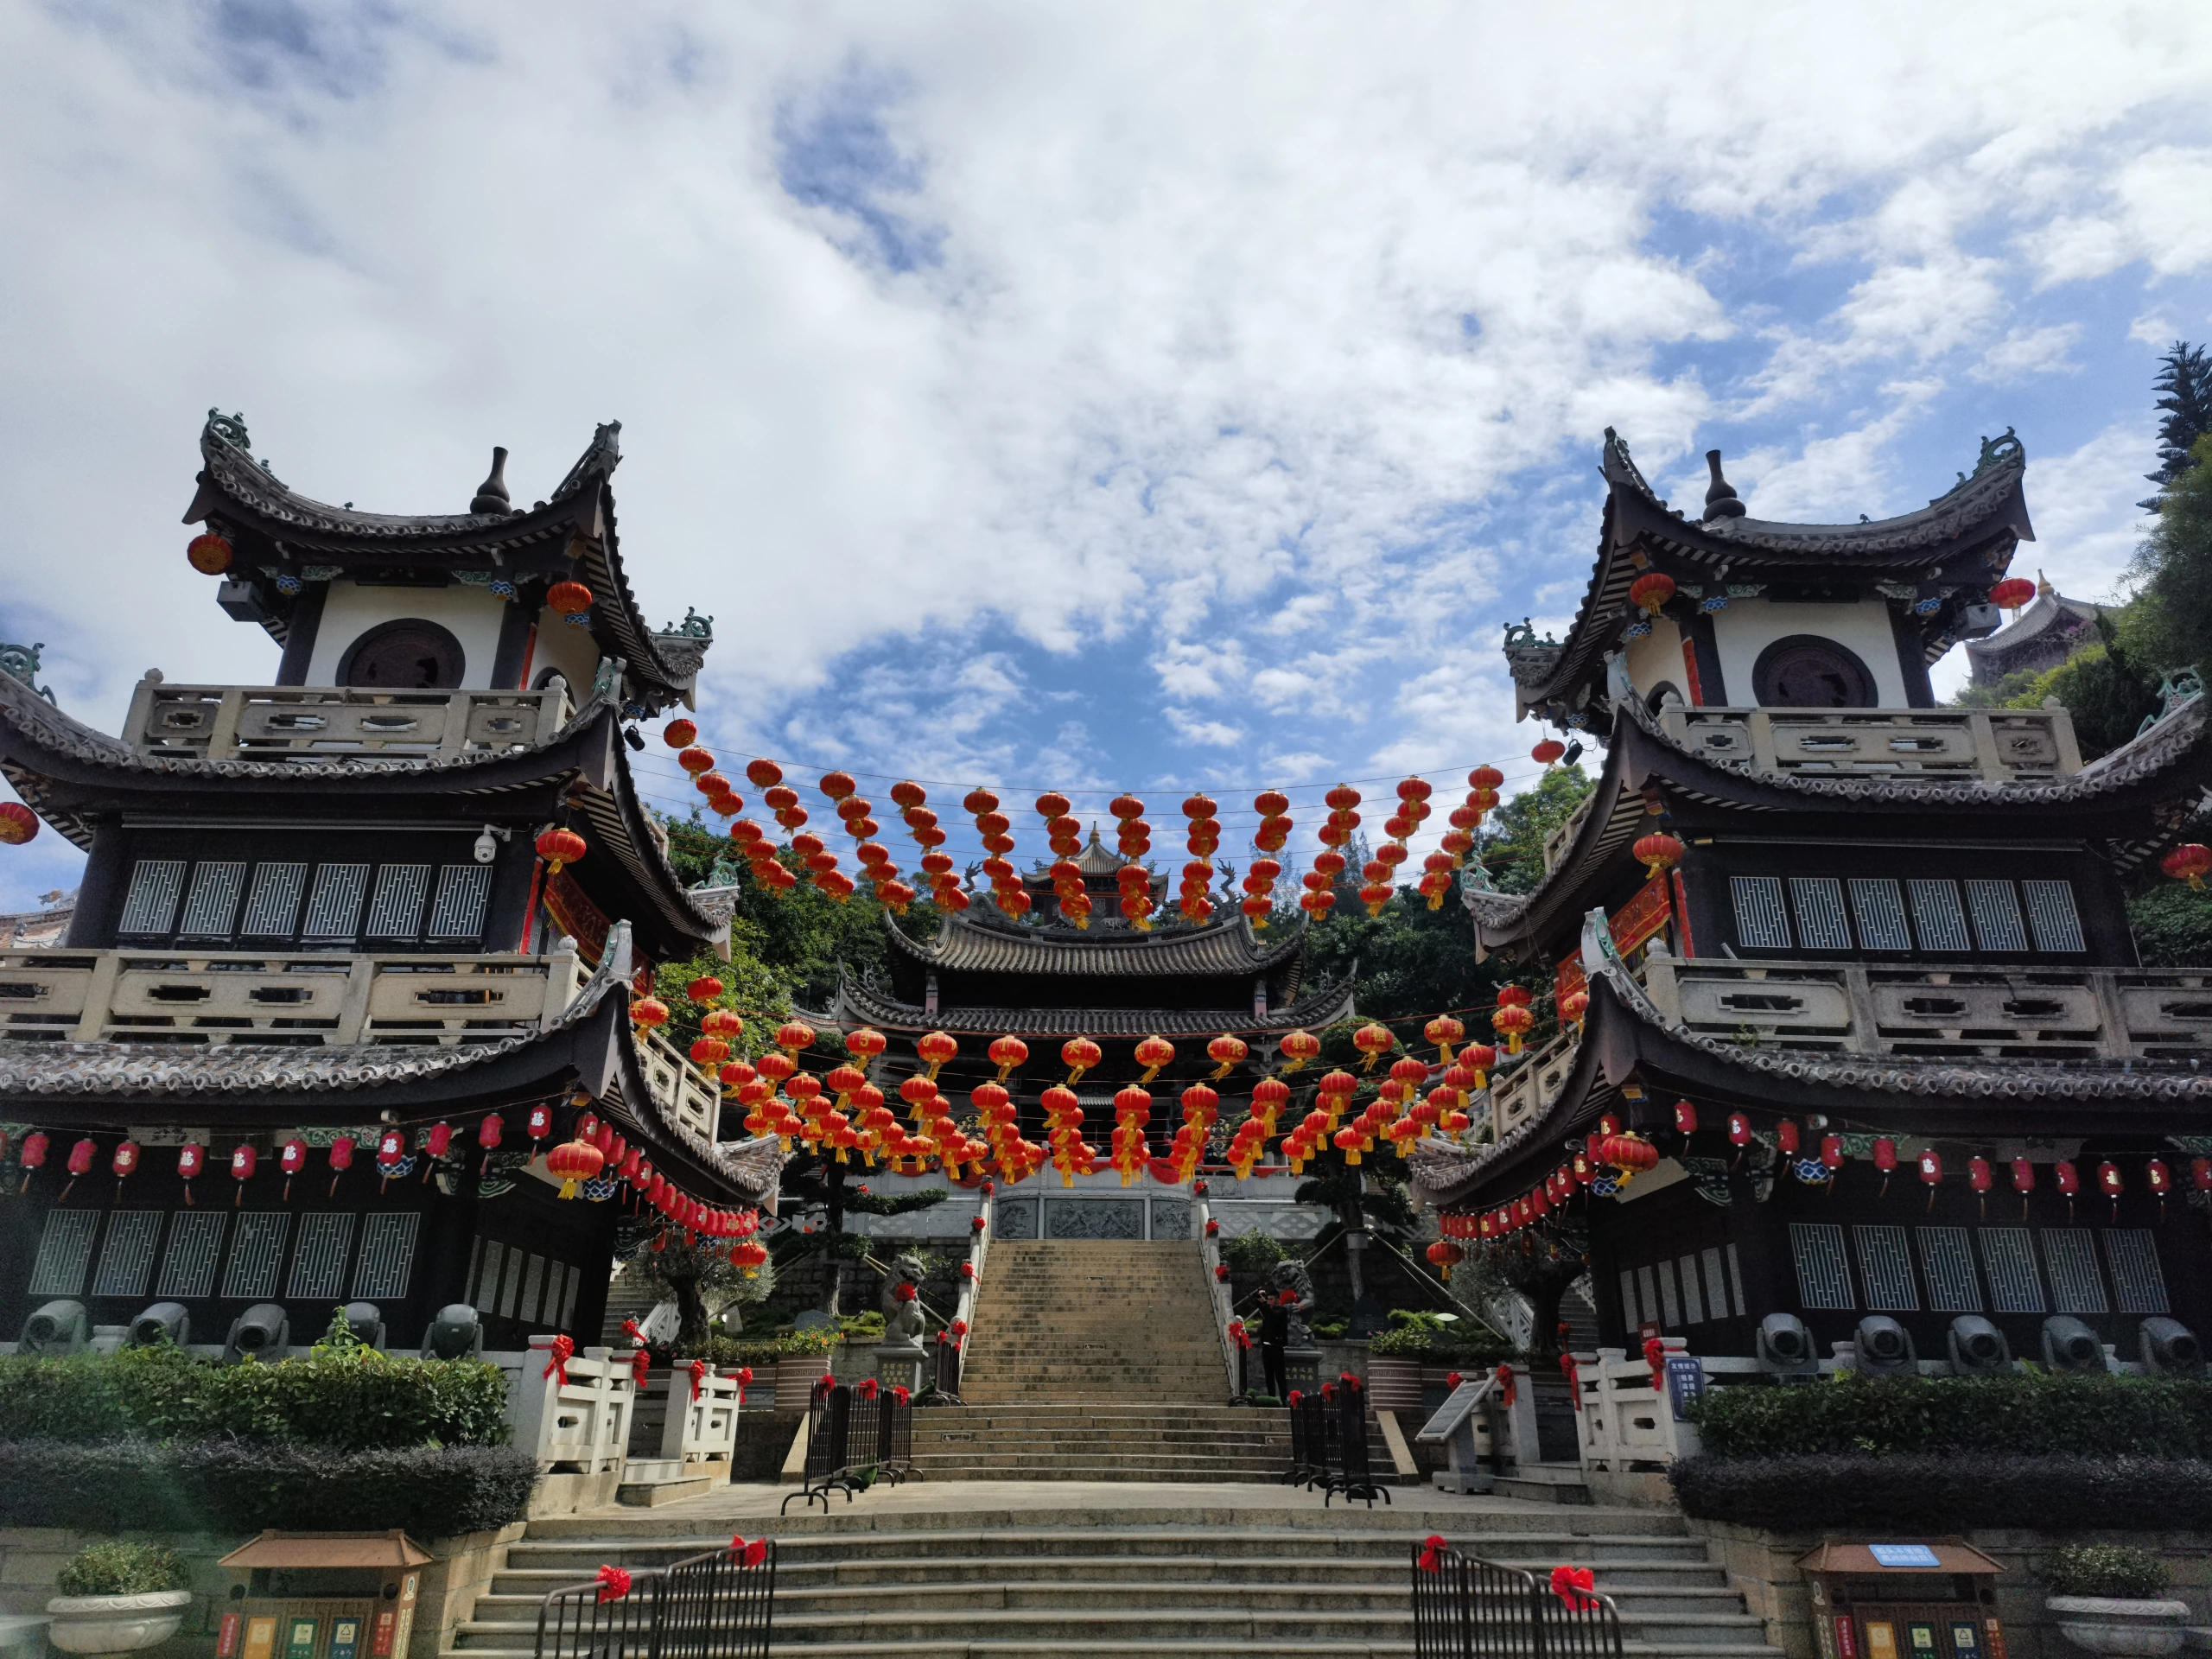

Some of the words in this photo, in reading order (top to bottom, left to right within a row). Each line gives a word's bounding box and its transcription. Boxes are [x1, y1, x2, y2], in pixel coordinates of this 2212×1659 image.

[631, 1002, 643, 1016] 年
[708, 1012, 721, 1027] 周
[861, 1033, 869, 1047] 3
[1068, 1042, 1082, 1055] 天
[1160, 1041, 1173, 1057] 升
[1230, 1041, 1243, 1056] 化
[1372, 1030, 1387, 1043] 祖
[531, 1111, 544, 1126] 福
[283, 1145, 296, 1160] 福
[383, 1138, 397, 1154] 福
[181, 1151, 194, 1166] 福
[233, 1152, 245, 1167] 福
[1574, 1159, 1586, 1173] 福
[1923, 1158, 1936, 1173] 福
